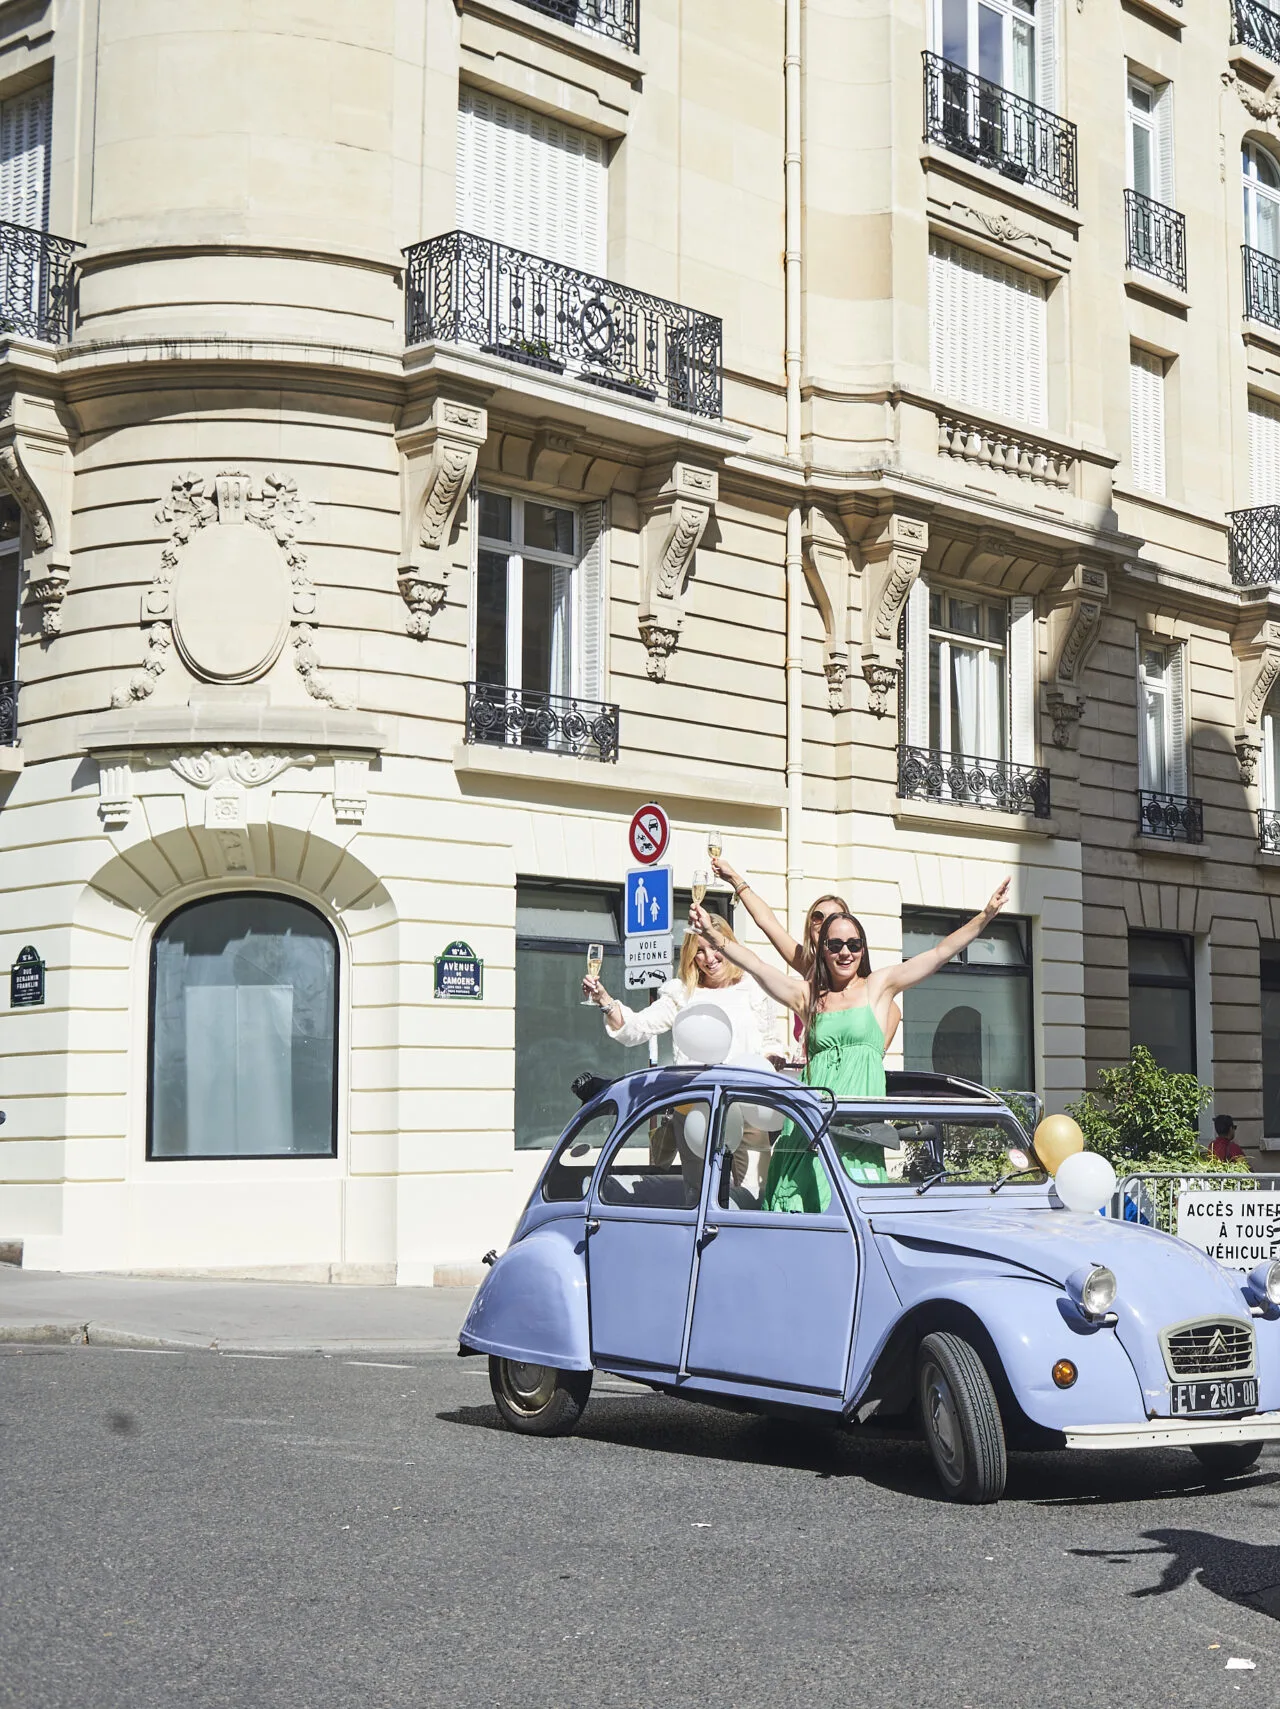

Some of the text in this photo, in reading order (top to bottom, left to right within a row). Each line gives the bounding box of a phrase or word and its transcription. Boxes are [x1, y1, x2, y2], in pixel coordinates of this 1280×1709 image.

[640, 940, 657, 950] VOIE
[629, 950, 667, 962] PIÉTONNE
[443, 961, 474, 972] AVENUE
[16, 974, 39, 983] BENJAMIN
[16, 981, 38, 989] FRANKLIN
[1187, 1200, 1234, 1217] ACCÈS
[1219, 1221, 1274, 1238] À TOUS
